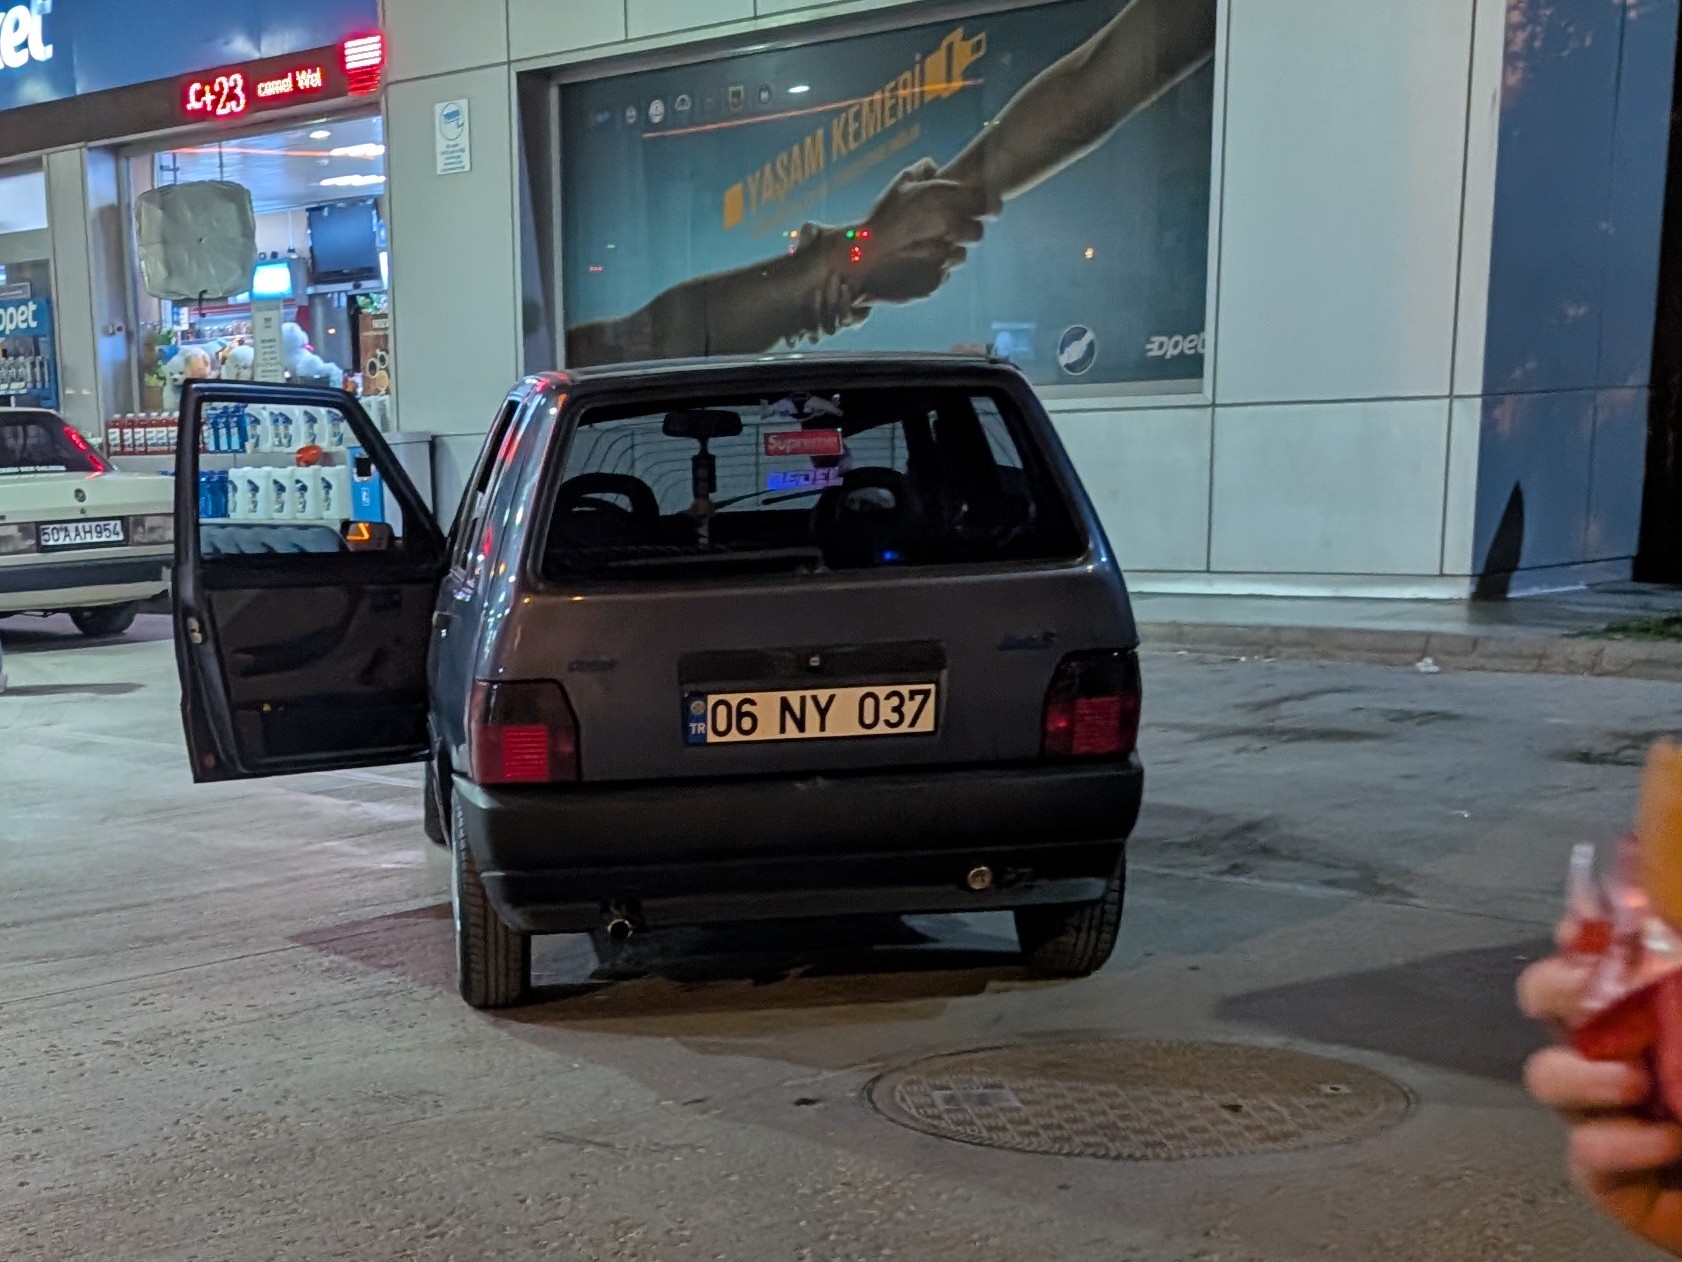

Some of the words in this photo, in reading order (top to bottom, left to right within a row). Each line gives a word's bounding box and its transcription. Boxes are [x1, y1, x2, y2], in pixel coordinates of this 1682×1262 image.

[0, 0, 53, 69] et
[689, 722, 706, 735] TR
[710, 698, 758, 737] 06
[778, 693, 835, 734] NY
[858, 688, 932, 730] 037
